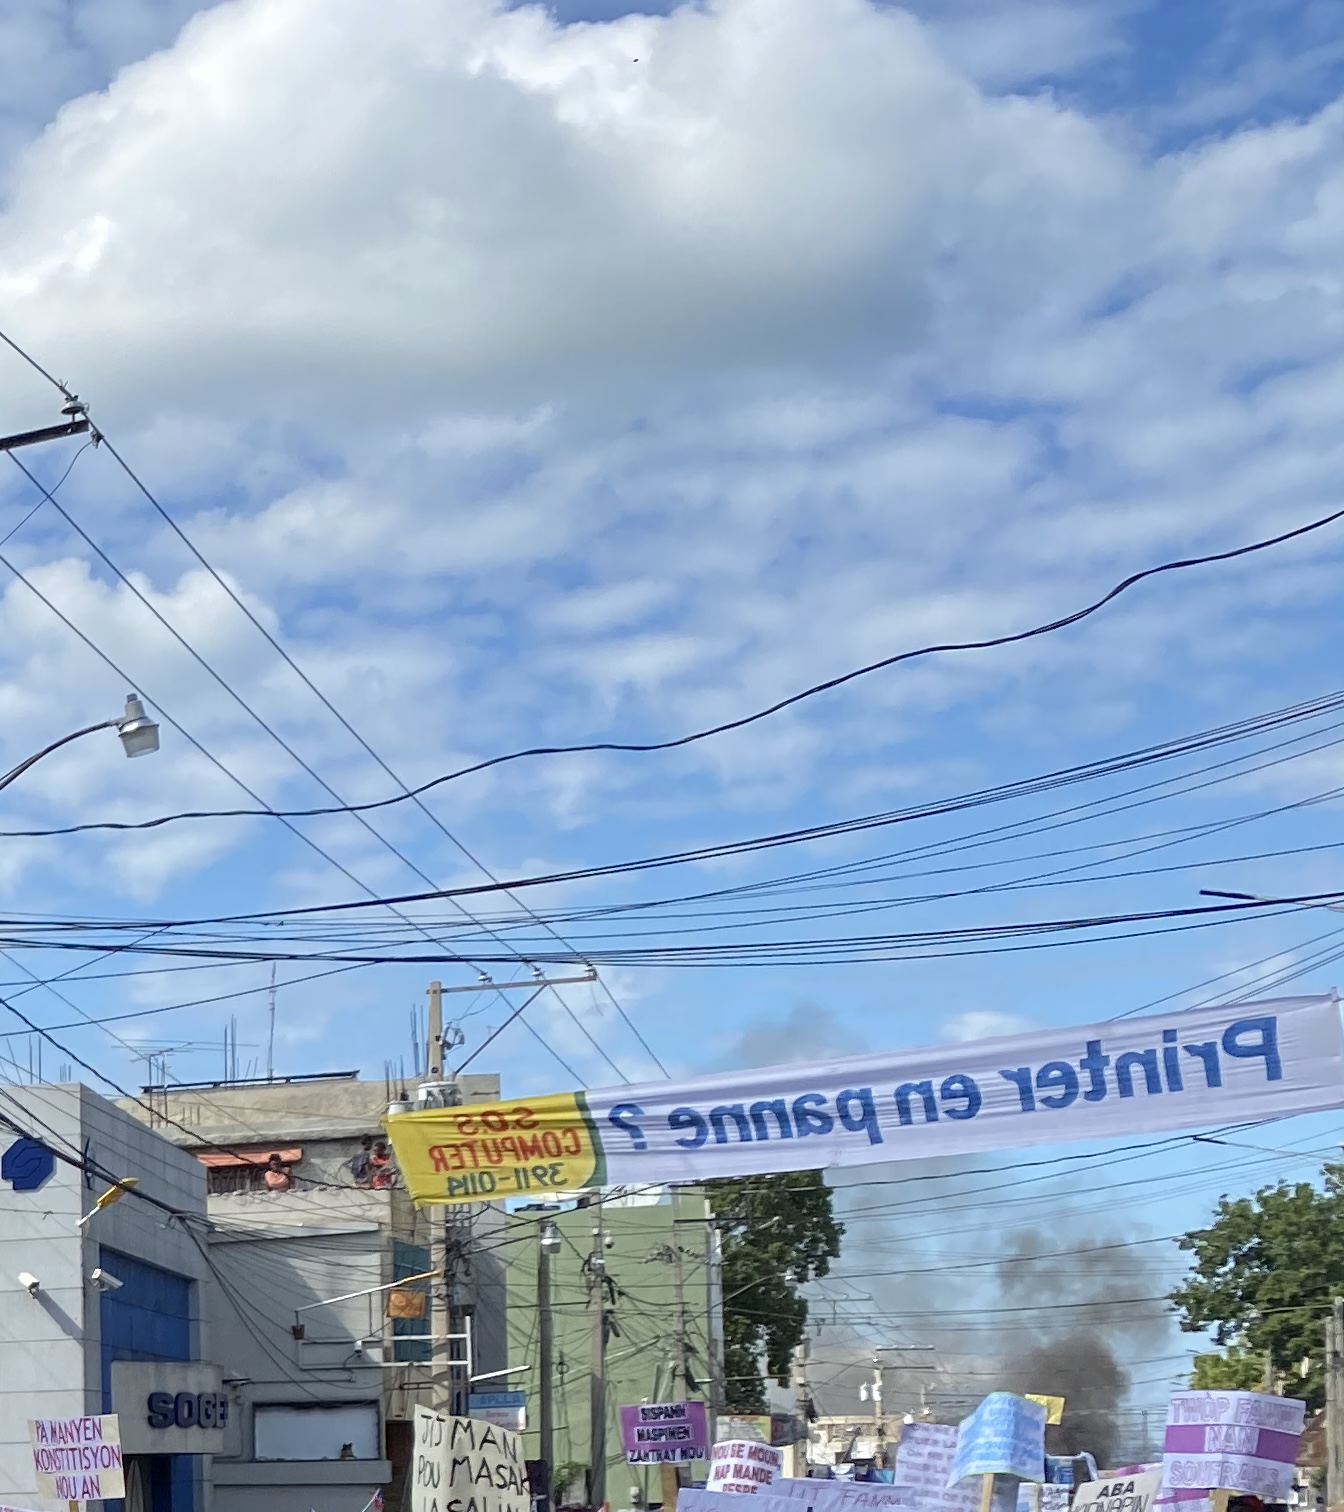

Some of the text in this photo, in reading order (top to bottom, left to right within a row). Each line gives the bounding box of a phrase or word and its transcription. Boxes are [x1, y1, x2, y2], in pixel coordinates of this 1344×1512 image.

[34, 1417, 103, 1445] PA MANYEN
[451, 1419, 518, 1463] MAN
[1207, 1426, 1256, 1454] NAN
[33, 1445, 122, 1472] KONSTITISYON
[730, 1443, 746, 1459] SE
[417, 1455, 441, 1489] POU
[714, 1463, 773, 1486] NAP MANDE
[56, 1475, 101, 1500] NOU AN
[1097, 1480, 1135, 1499] ABA
